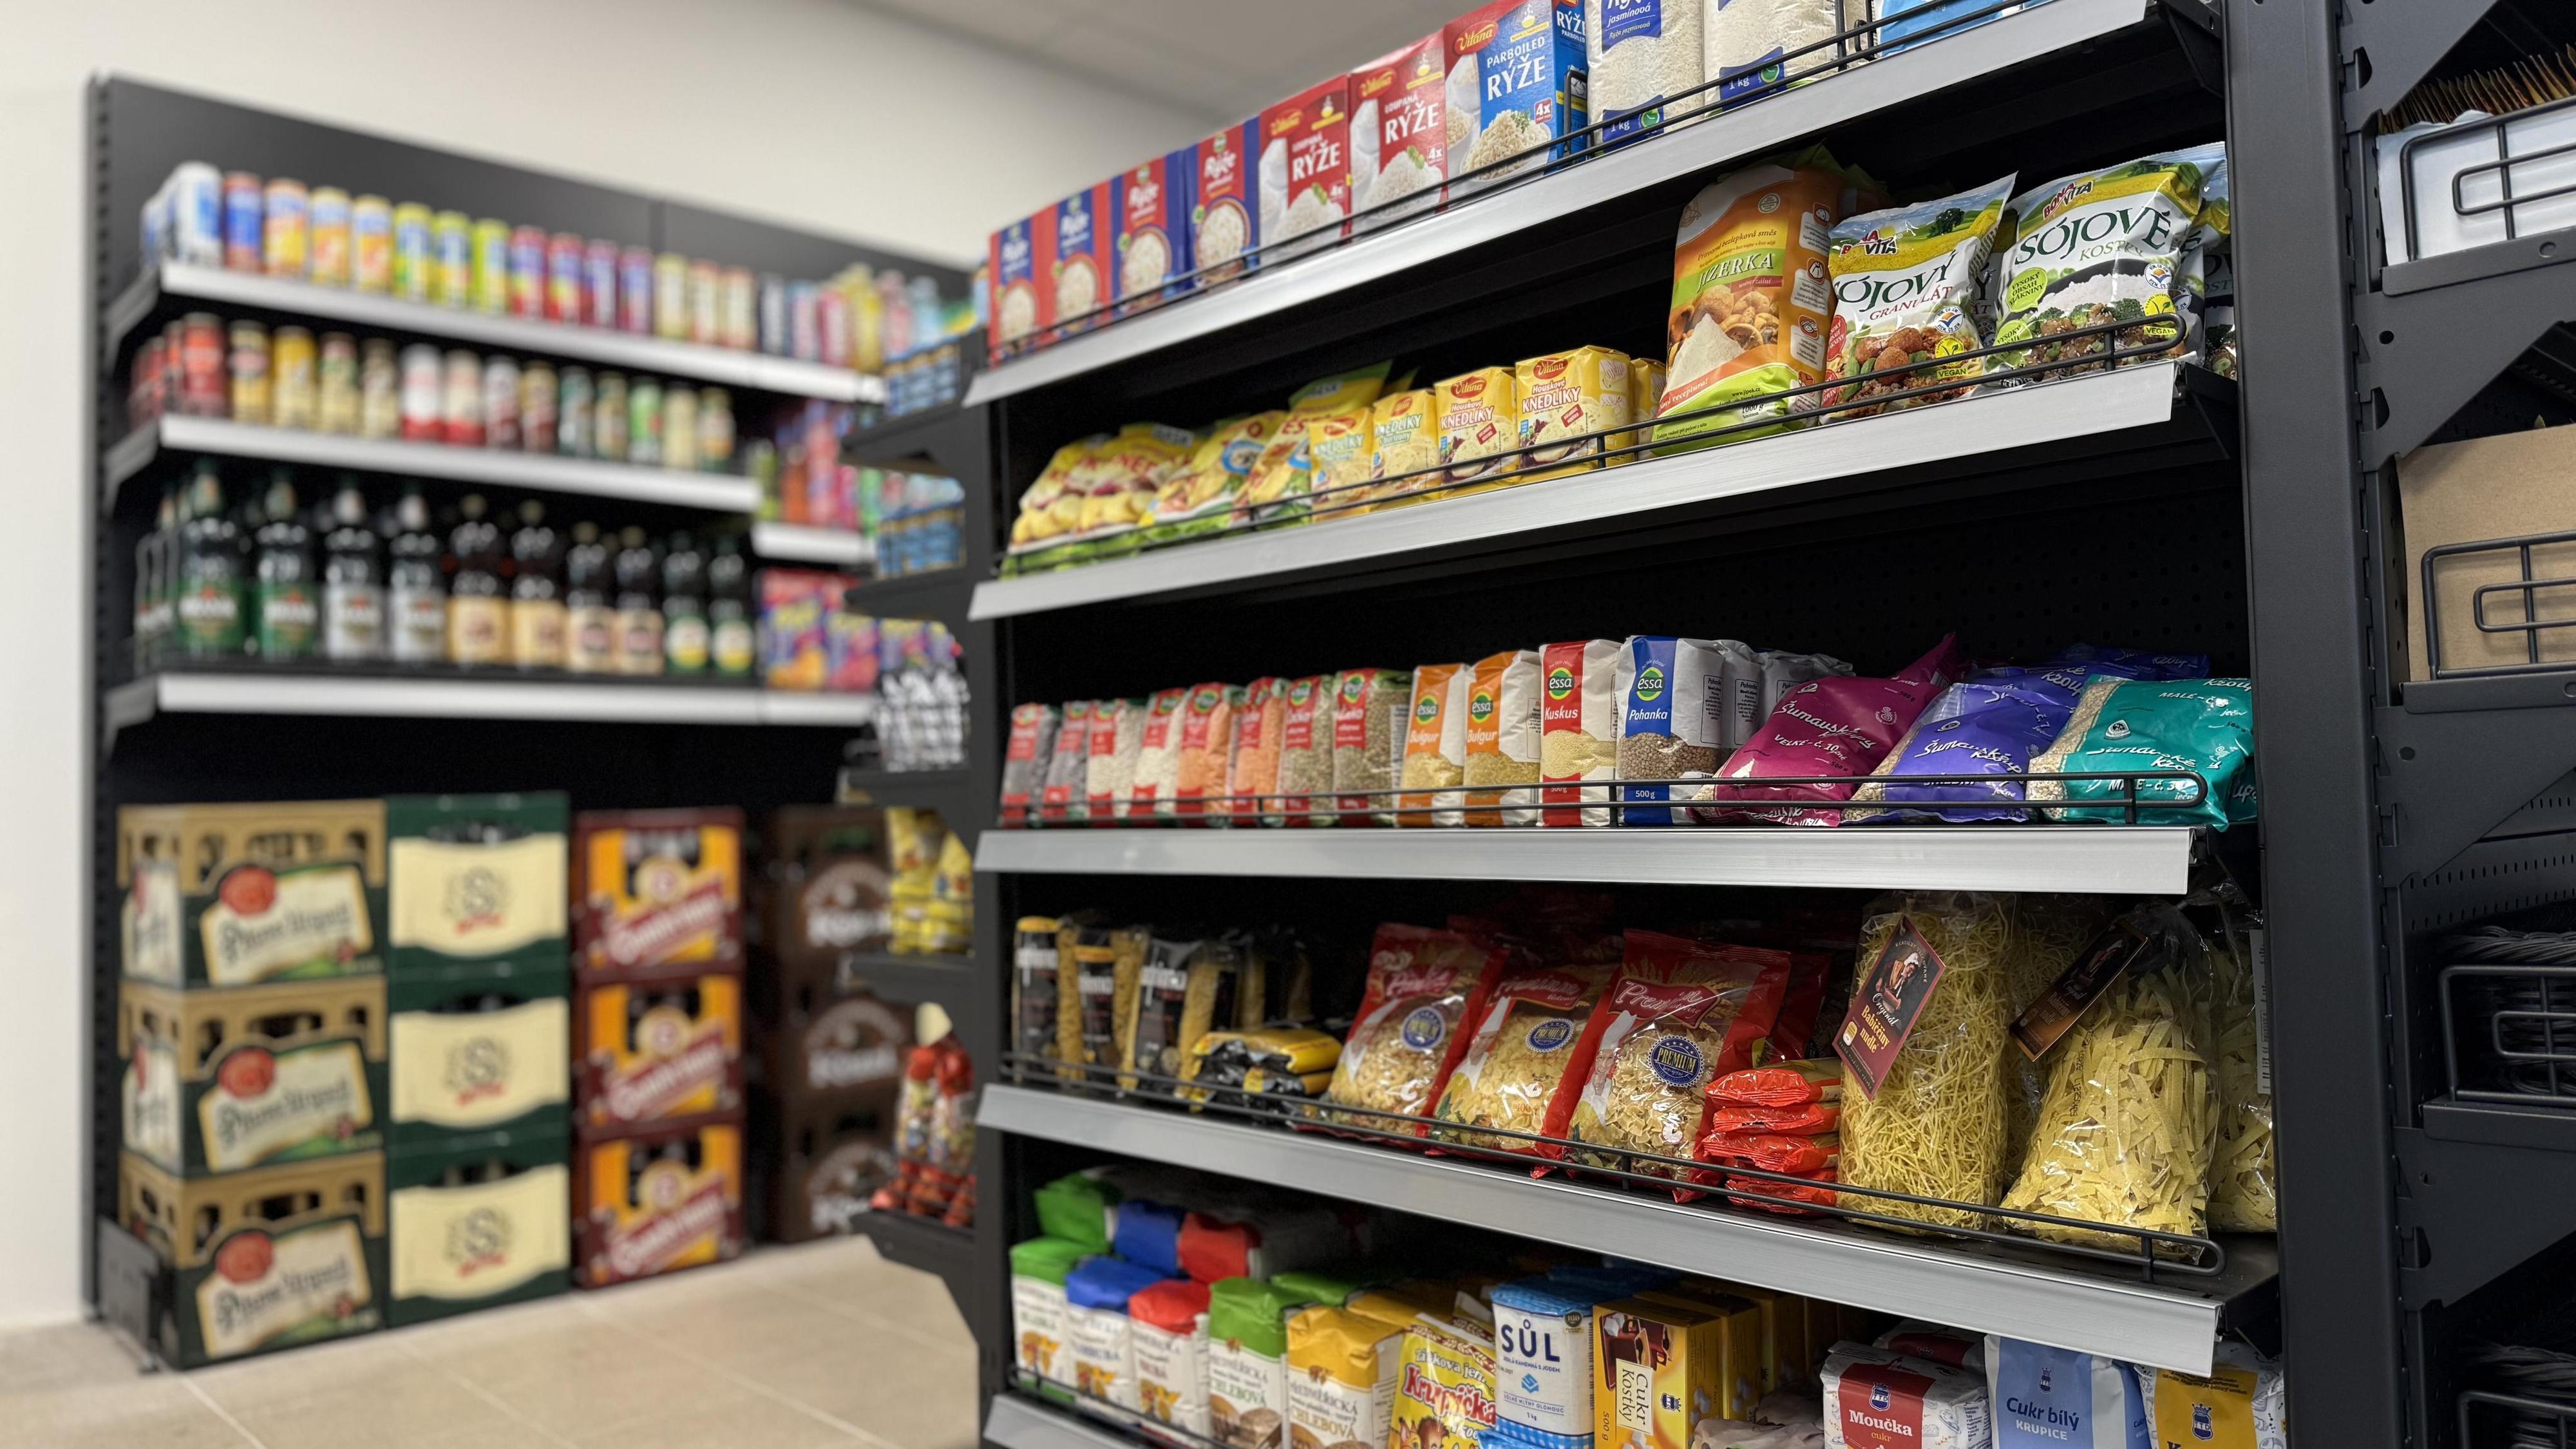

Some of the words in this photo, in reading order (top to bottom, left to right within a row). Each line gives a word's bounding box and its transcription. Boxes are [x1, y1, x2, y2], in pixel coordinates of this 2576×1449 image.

[1607, 2, 1651, 28] jasmínová
[1458, 23, 1495, 51] Vitana
[1487, 36, 1545, 68] PARBOILED
[1488, 55, 1546, 101] RÝŽE
[1738, 77, 1749, 87] kg
[1536, 103, 1551, 116] 4x
[1386, 99, 1439, 145] RÝŽE
[1618, 120, 1630, 129] kg
[1293, 137, 1341, 182] RÝŽE
[2043, 182, 2074, 218] BONA
[2062, 180, 2093, 205] VITA
[1721, 230, 1757, 249] bezlepková
[1757, 229, 1777, 238] směs
[2015, 206, 2172, 265] SÓJOVÉ
[2079, 240, 2143, 261] KOSTKY
[1697, 252, 1774, 294] JIZERKA
[1835, 249, 1956, 313] ÓJOVÝ
[2012, 272, 2040, 290] VYSOKÝ
[2012, 280, 2037, 296] OBSAH
[1870, 285, 1953, 321] GRANULÁT
[1938, 368, 1966, 377] VEGAN
[1533, 377, 1566, 394] Houskové
[1452, 397, 1483, 413] Houskové
[1522, 386, 1581, 413] KNEDLÍKY
[1440, 406, 1494, 430] KNEDLÍKY
[1549, 677, 1572, 689] essa
[1638, 677, 1663, 690] essa
[1417, 704, 1437, 715] essa
[1472, 701, 1492, 713] essa
[1544, 705, 1578, 720] Kuskus
[1629, 708, 1668, 721] Pohanka
[1410, 729, 1440, 745] Bulgur
[1467, 728, 1497, 744] Bulgur
[1872, 992, 1900, 1027] Originál
[1861, 1005, 1890, 1050] Babiččiny
[1859, 1027, 1878, 1054] nudle
[1656, 1046, 1697, 1074] PREMIUM
[1501, 1319, 1560, 1363] SŮL
[1515, 1359, 1537, 1369] KAMENNÁ
[1542, 1365, 1560, 1373] JODEM
[1404, 1364, 1496, 1426] Krupička
[1519, 1397, 1535, 1407] MLÝNY
[1537, 1403, 1564, 1413] OLOMOUC
[1618, 1368, 1636, 1422] Kostky
[1636, 1372, 1649, 1425] Cukr
[1849, 1409, 1913, 1437] Moučka
[2006, 1397, 2045, 1420] Cukr
[2048, 1406, 2079, 1432] bílý
[2195, 1421, 2210, 1431] TTD
[1871, 1431, 1892, 1443] cukr
[2016, 1419, 2068, 1441] KRUPICE
